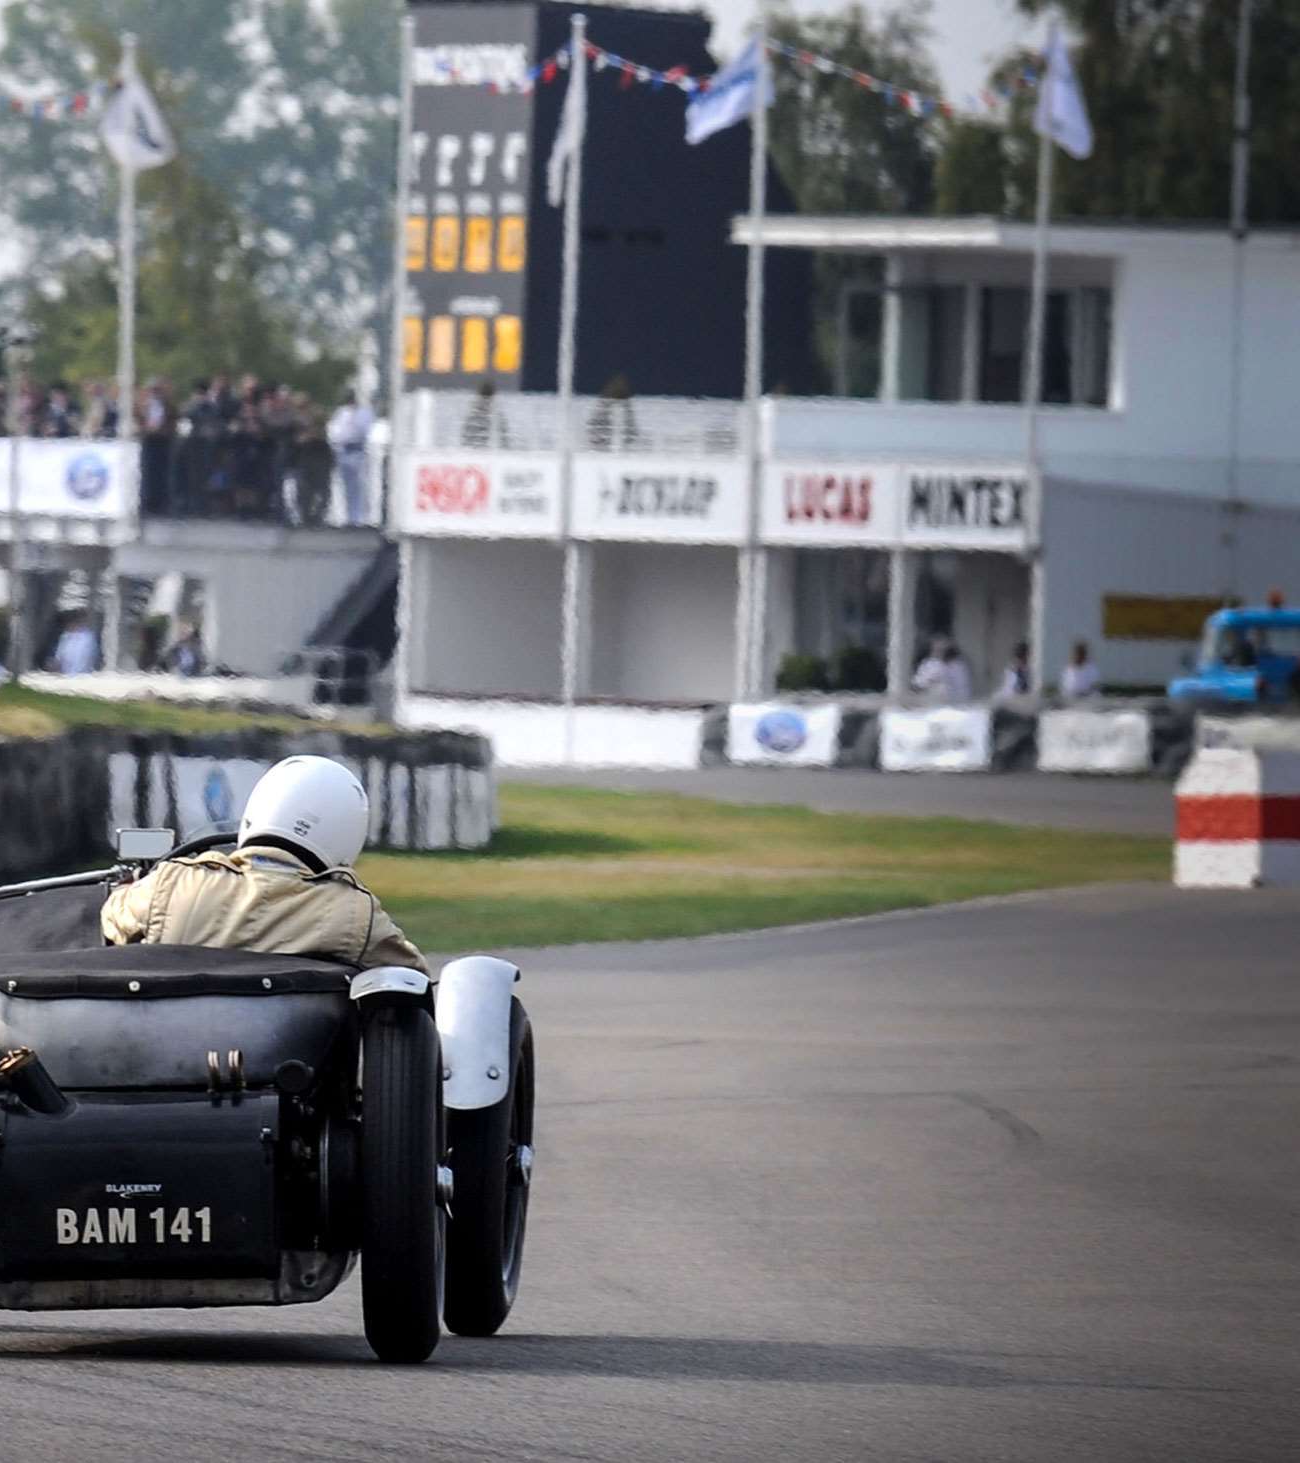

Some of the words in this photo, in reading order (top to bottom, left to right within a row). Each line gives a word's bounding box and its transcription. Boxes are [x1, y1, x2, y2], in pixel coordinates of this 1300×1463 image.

[784, 474, 873, 526] LUCAS
[908, 476, 1028, 530] MINTEX
[105, 1184, 162, 1193] BLAKENEY
[56, 1208, 137, 1245] BAM
[150, 1207, 211, 1244] 141
